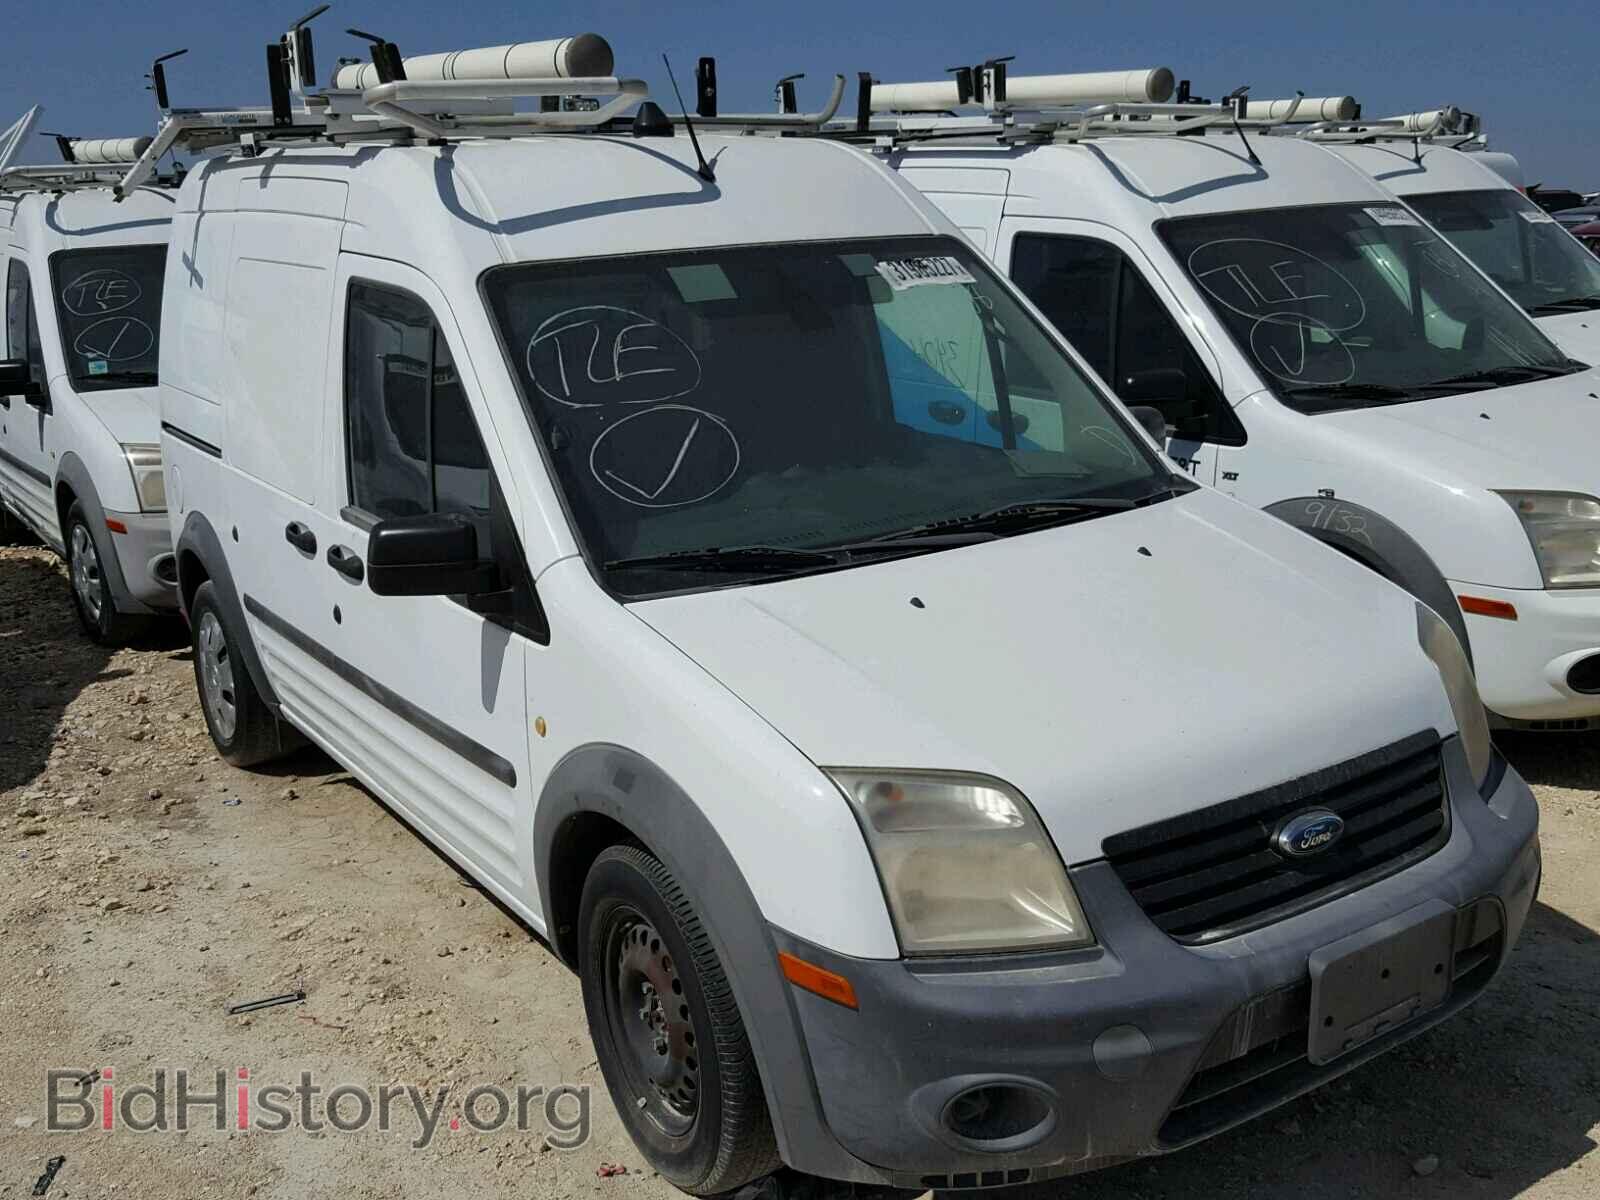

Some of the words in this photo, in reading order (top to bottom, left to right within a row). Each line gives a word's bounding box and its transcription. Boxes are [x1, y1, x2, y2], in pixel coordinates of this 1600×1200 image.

[75, 279, 129, 307] TLE
[1199, 259, 1331, 307] TLE
[532, 319, 677, 396] TLE
[1221, 471, 1240, 481] XLT
[1300, 824, 1333, 849] Ford
